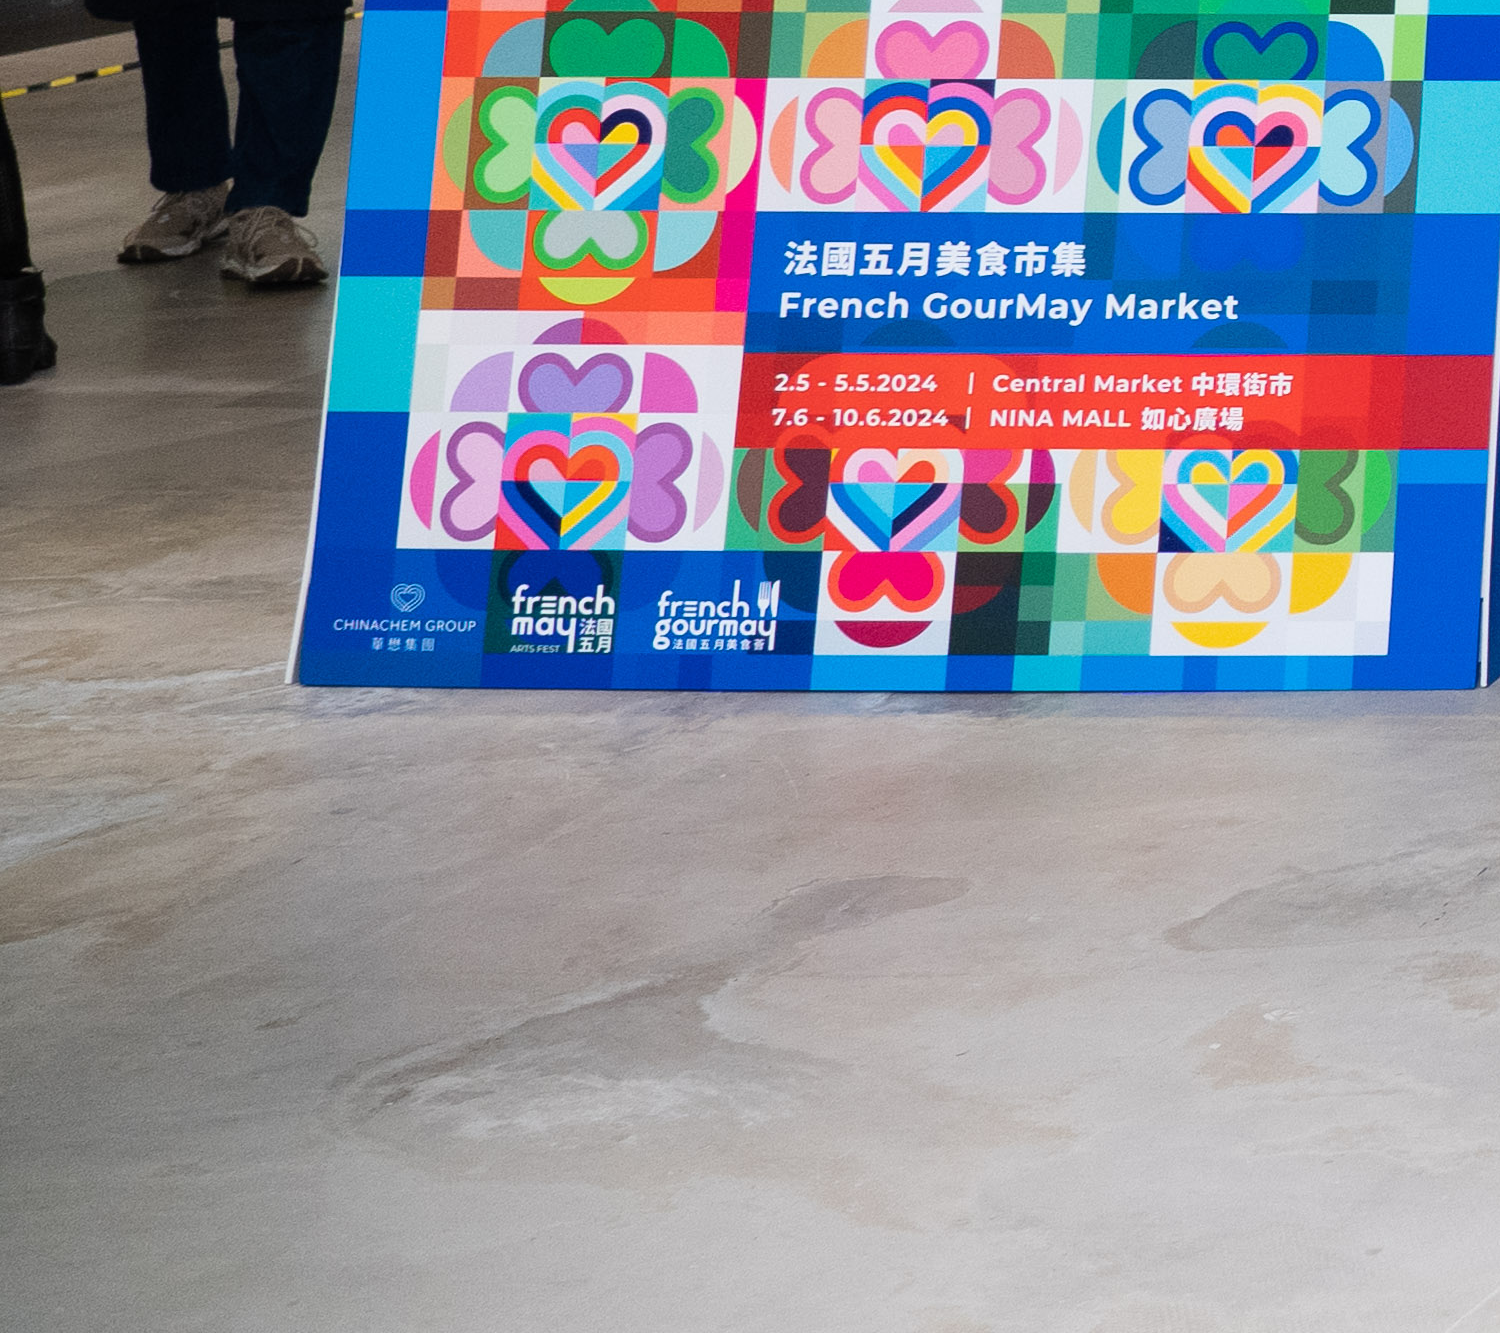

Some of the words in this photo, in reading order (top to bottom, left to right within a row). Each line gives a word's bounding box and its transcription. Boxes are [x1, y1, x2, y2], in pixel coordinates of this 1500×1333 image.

[783, 240, 1088, 278] 法國五月美食市集
[779, 292, 909, 319] French
[922, 293, 1094, 327] GourMay
[1104, 293, 1239, 321] Market
[774, 373, 811, 394] 2.5
[833, 373, 938, 394] 5.5.2024
[992, 373, 1086, 394] Central
[1093, 373, 1183, 394] Market
[1190, 372, 1294, 398] 中環街市
[771, 408, 808, 427] 7.6
[832, 408, 949, 428] 10.6.2024
[989, 408, 1055, 428] NINA
[1061, 408, 1132, 428] MALL
[1139, 406, 1245, 432] 如心廣場
[511, 583, 615, 616] french
[657, 579, 750, 618] french
[332, 618, 422, 632] CHINACHEM
[425, 619, 477, 633] GROUP
[511, 616, 577, 654] may
[578, 617, 612, 635] 法國
[652, 618, 779, 651] gourmay
[510, 644, 537, 653] ARTS
[538, 644, 560, 653] FEST
[578, 636, 612, 654] 五月
